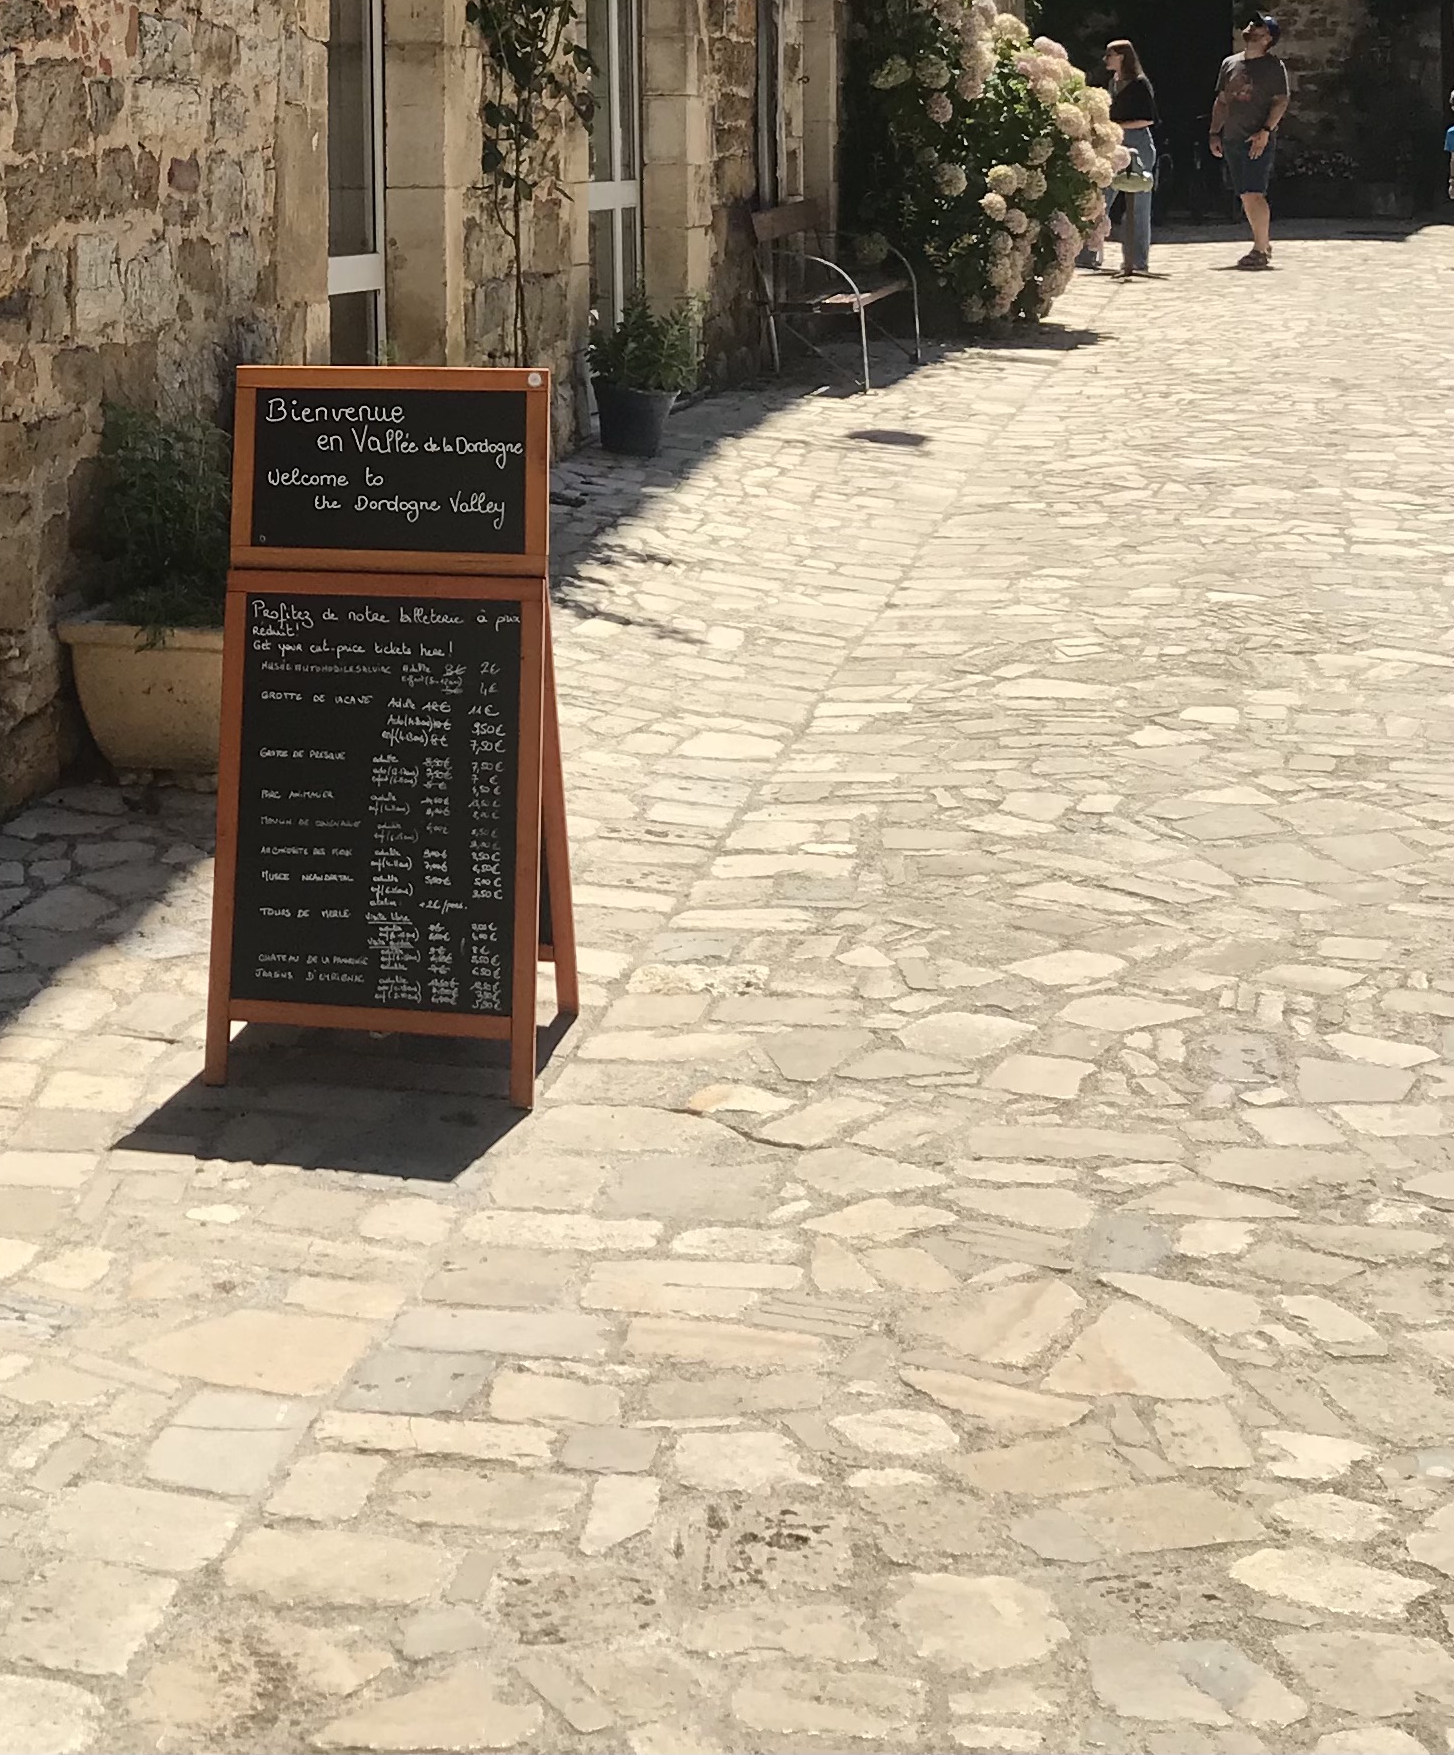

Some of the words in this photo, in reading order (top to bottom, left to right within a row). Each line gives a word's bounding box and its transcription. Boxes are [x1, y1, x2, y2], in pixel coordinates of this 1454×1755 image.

[265, 397, 406, 423] Bienvenue
[317, 433, 343, 453] en
[350, 424, 419, 454] Vallée
[424, 437, 441, 452] de
[442, 437, 453, 452] la
[456, 436, 524, 470] Dordogne
[267, 468, 349, 487] Welcome
[364, 467, 384, 486] to
[314, 495, 342, 511] the
[354, 495, 441, 523] Dordogne
[449, 490, 506, 530] Valley
[251, 599, 314, 629] Profitez
[322, 607, 339, 621] de
[347, 605, 390, 623] notre
[477, 609, 488, 623] à
[495, 614, 521, 632] prix
[253, 640, 272, 652] Get
[278, 642, 303, 659] your
[309, 638, 366, 659] cut-price
[374, 642, 412, 656] tickets
[260, 691, 303, 701] GROTTE
[312, 694, 326, 702] DE
[297, 909, 310, 918] DE
[306, 954, 319, 965] DE
